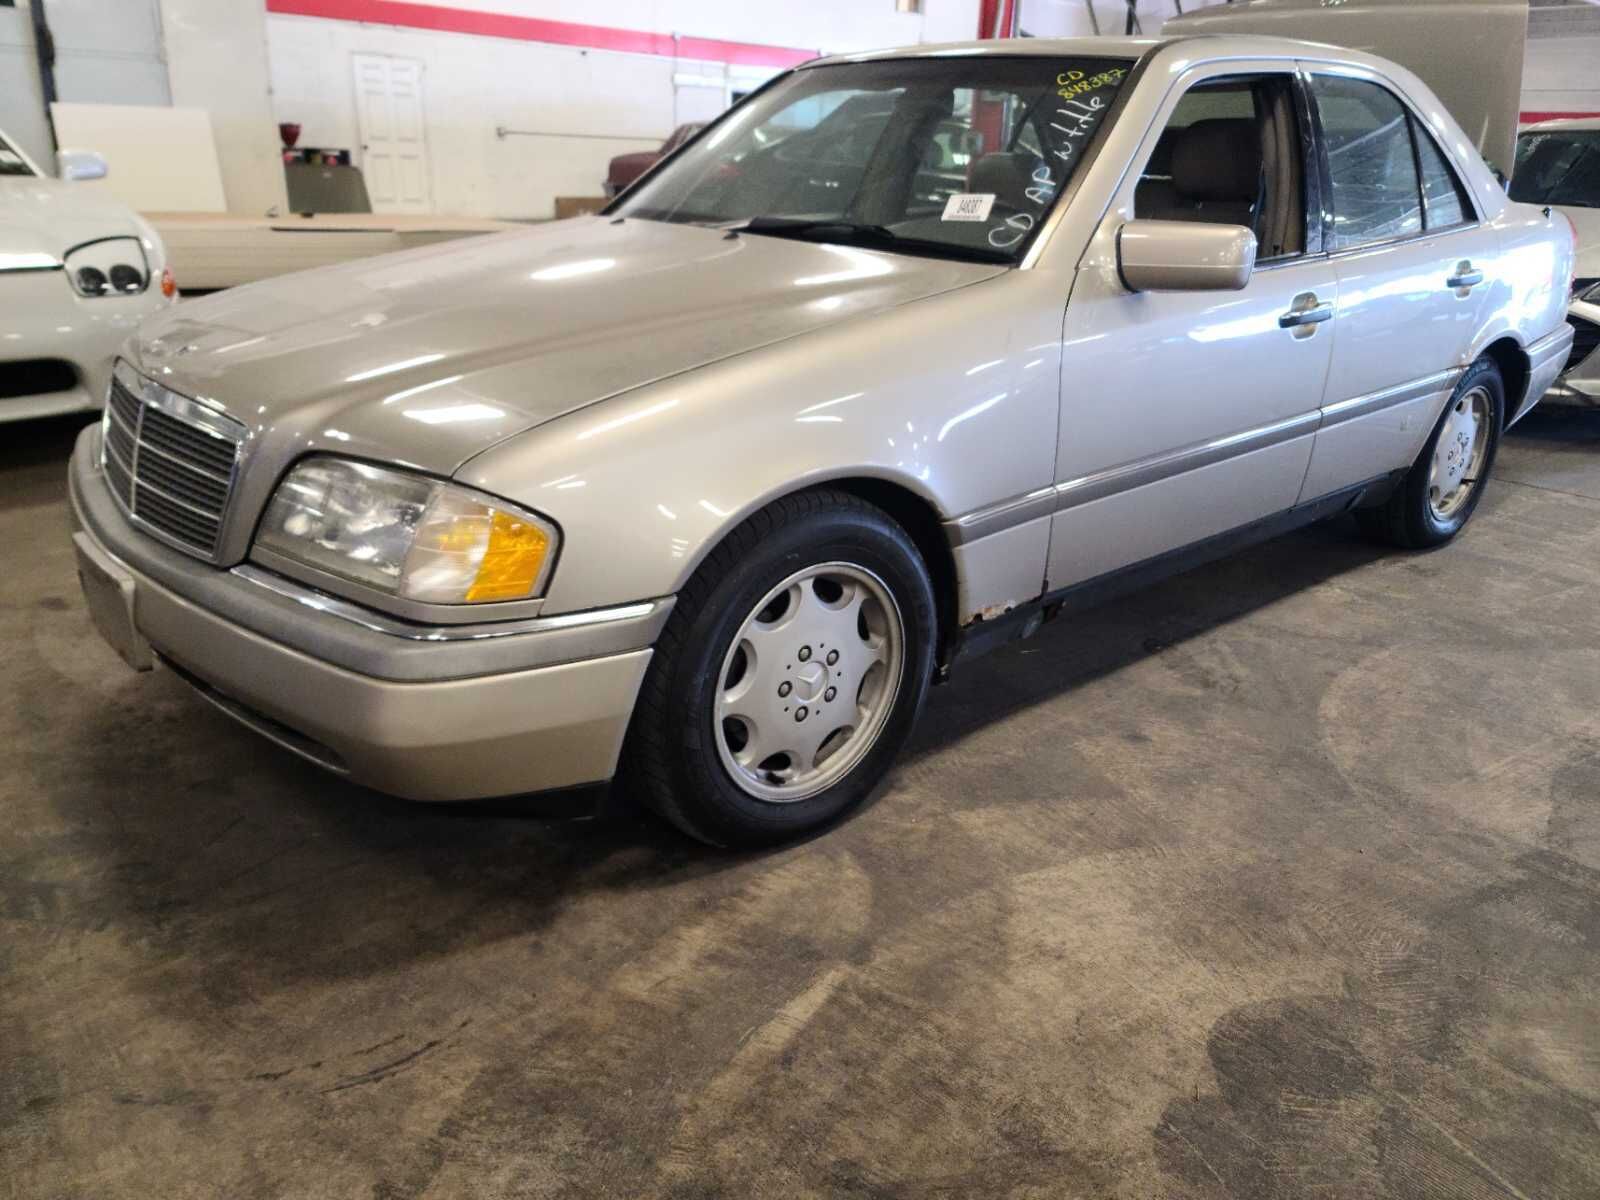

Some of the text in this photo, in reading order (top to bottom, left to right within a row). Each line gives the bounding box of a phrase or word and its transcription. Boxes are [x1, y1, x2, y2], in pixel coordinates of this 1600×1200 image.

[1056, 70, 1085, 86] CD
[1057, 68, 1128, 100] 848387
[988, 212, 1034, 247] CD
[1024, 166, 1057, 204] AP
